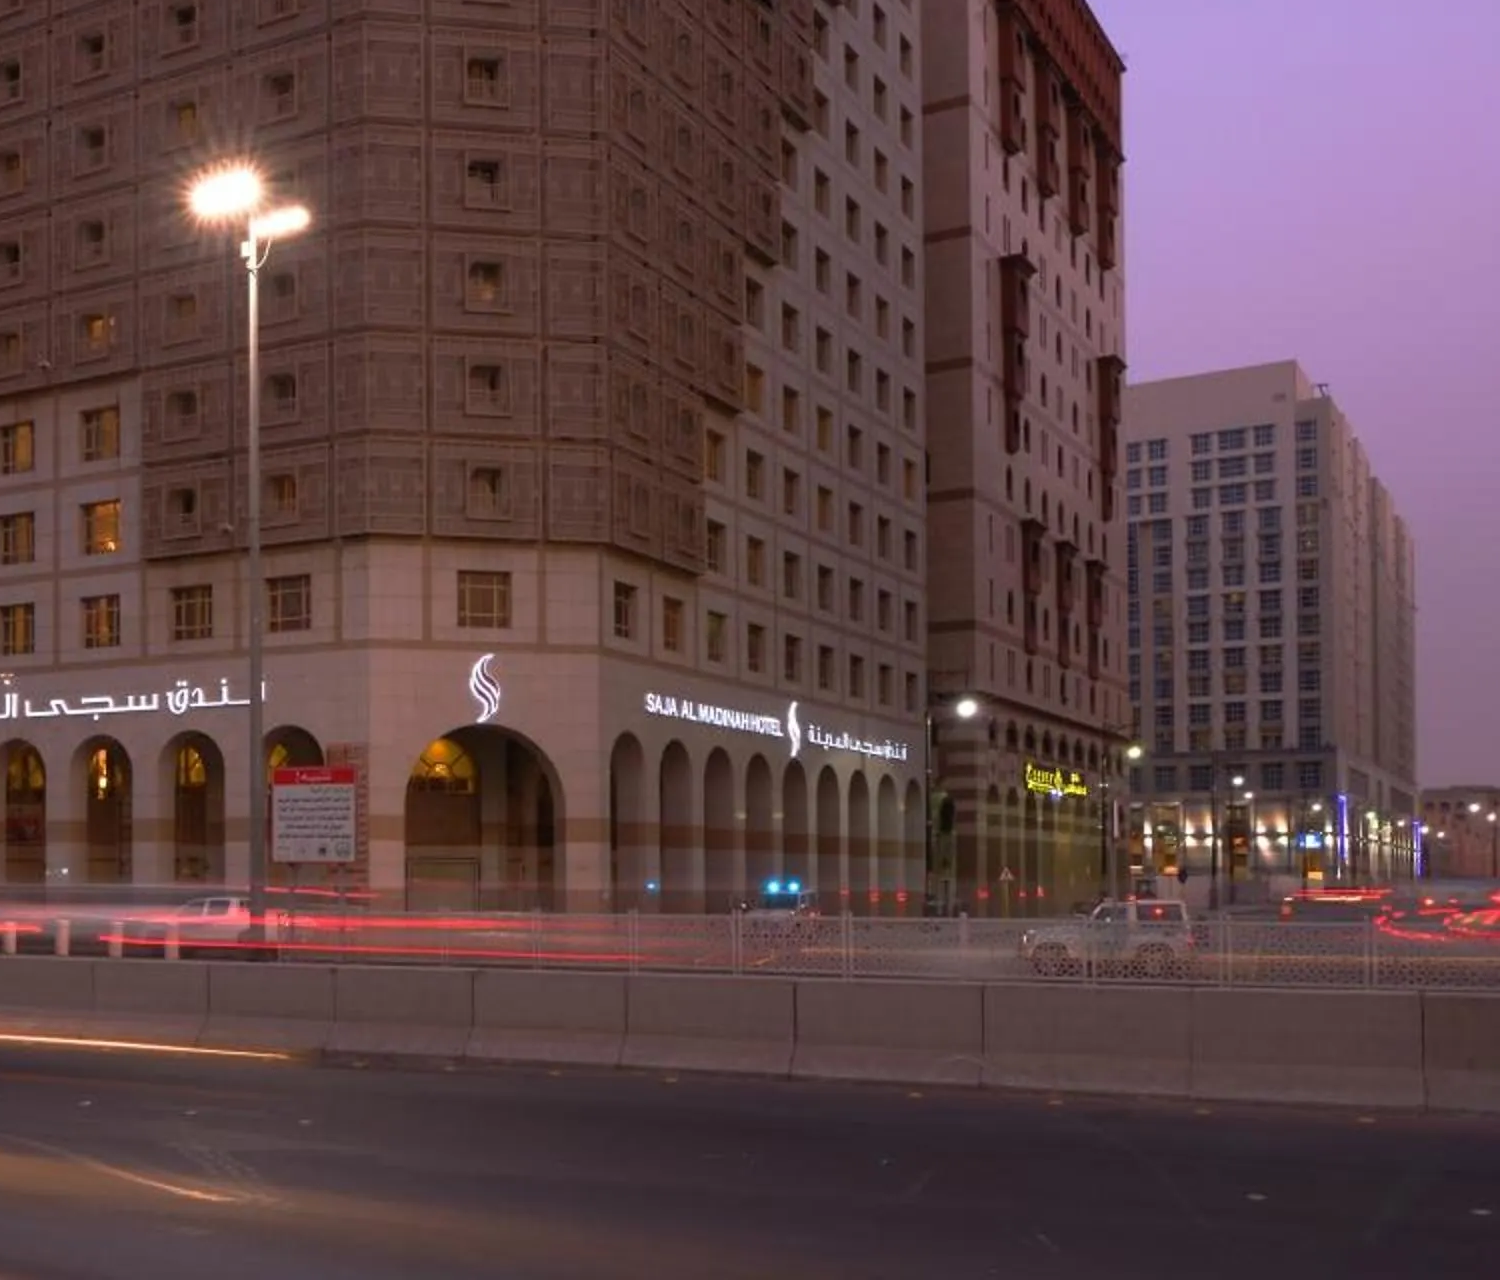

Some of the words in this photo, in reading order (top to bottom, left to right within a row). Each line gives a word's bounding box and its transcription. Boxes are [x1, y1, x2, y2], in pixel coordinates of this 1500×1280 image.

[23, 692, 160, 721] سجى
[645, 692, 679, 717] SAJA
[681, 699, 698, 721] AL
[698, 703, 749, 731] MADINAH
